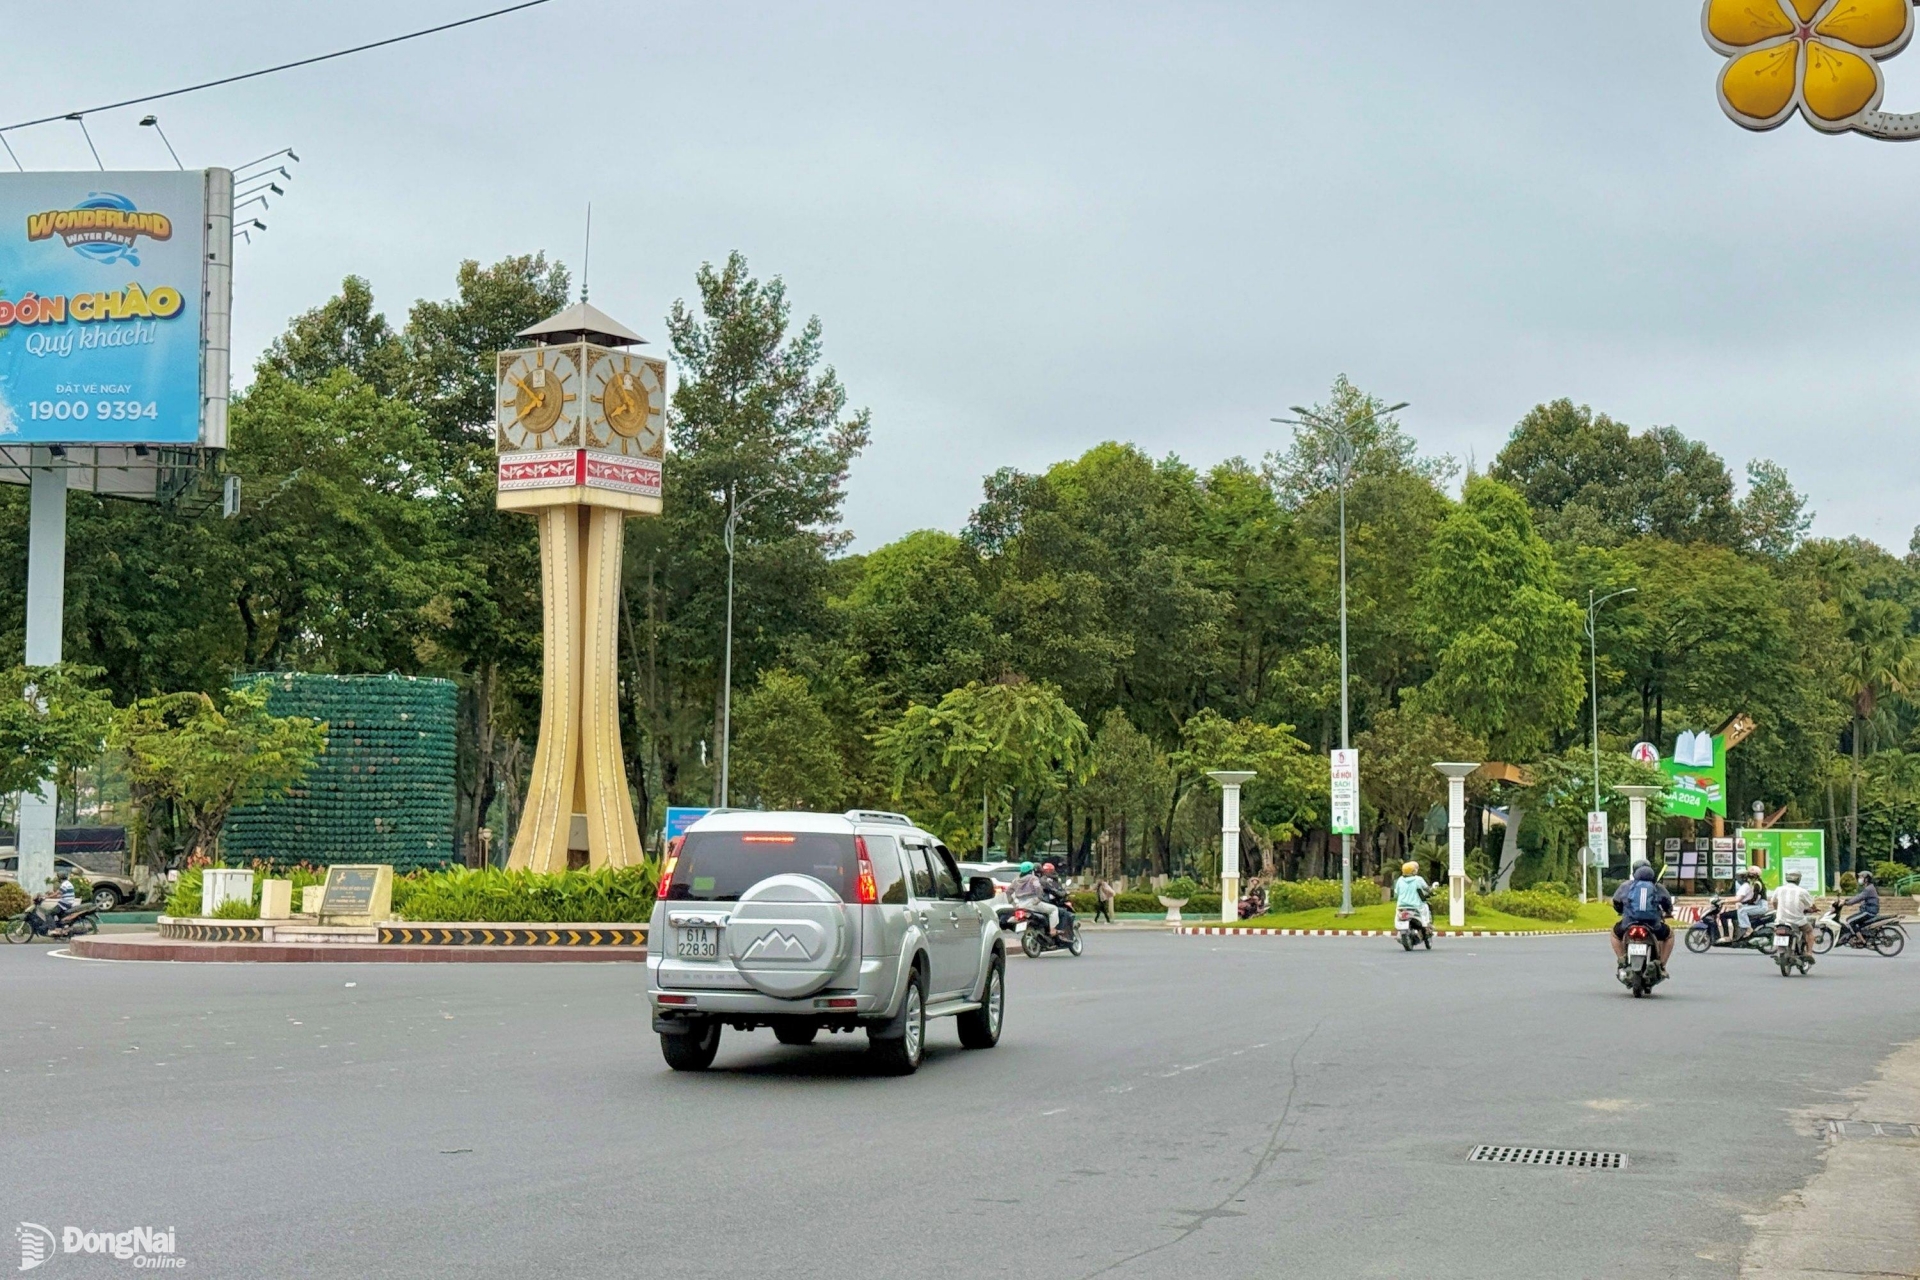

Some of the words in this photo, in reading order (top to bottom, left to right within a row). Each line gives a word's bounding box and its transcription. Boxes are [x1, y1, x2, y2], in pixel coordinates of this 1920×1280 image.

[28, 208, 171, 240] WONDERLAND
[66, 232, 102, 245] WATER
[104, 231, 132, 246] PARK
[0, 292, 65, 325] ĐÓN
[69, 283, 183, 321] CHÀO
[26, 328, 74, 357] Quý
[79, 321, 156, 349] khách!
[56, 381, 80, 396] ĐẶT
[100, 384, 132, 394] NGAY
[29, 400, 89, 421] 1900
[96, 400, 158, 421] 9394
[1678, 793, 1701, 807] 2024
[686, 928, 707, 942] 61A
[679, 943, 716, 956] 228.30
